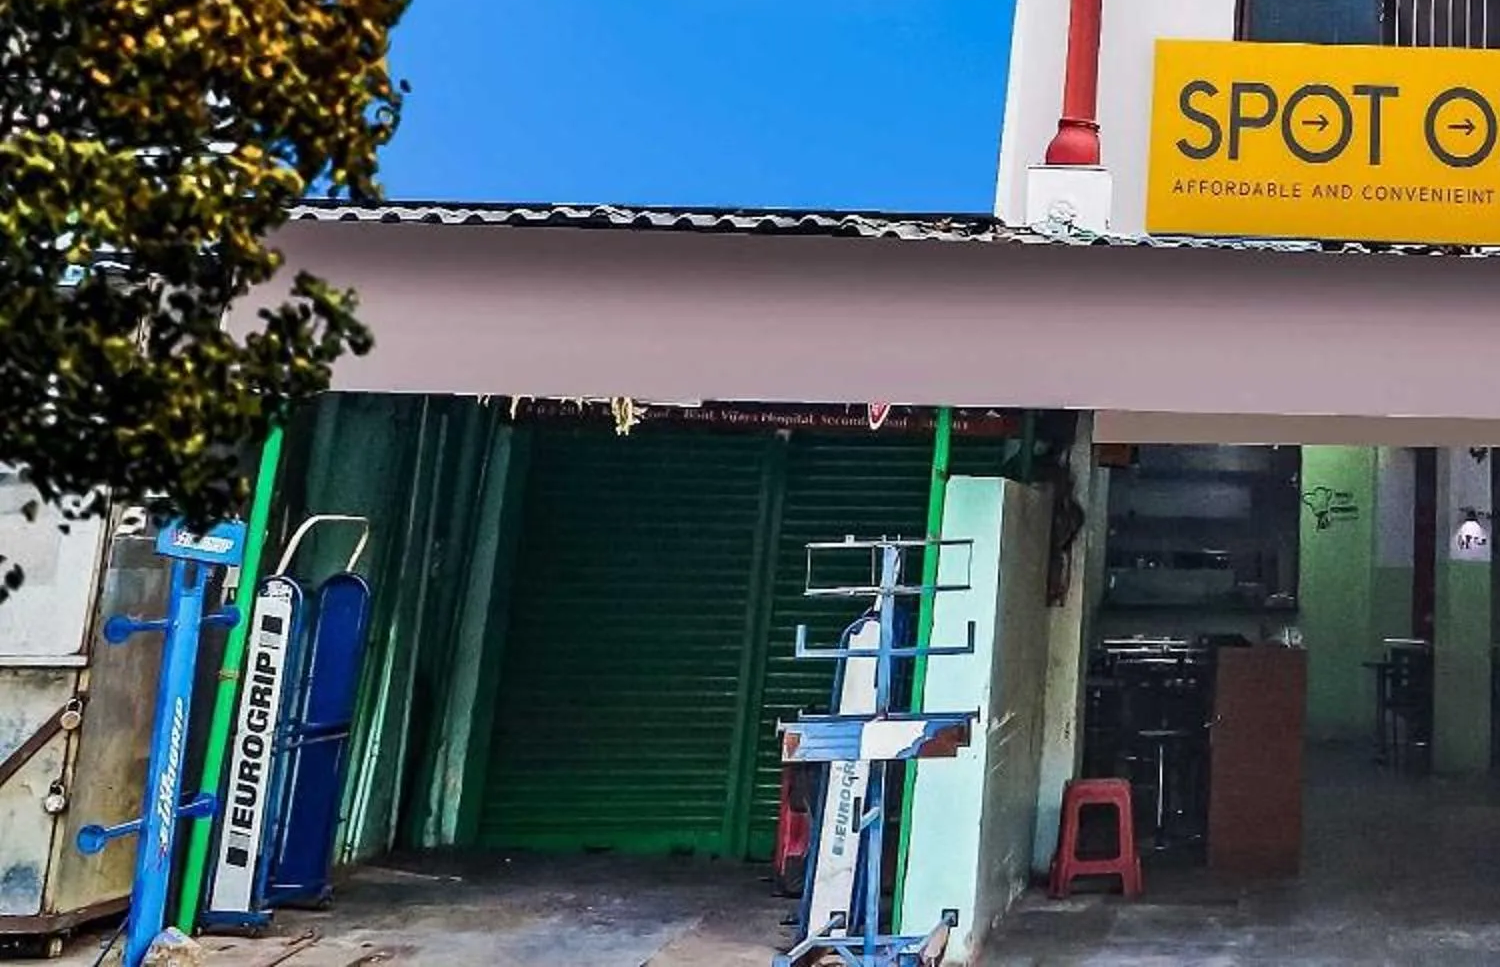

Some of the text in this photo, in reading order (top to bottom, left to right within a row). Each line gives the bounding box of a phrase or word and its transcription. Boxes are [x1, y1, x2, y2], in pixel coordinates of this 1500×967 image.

[1176, 80, 1399, 166] SPOT
[1172, 178, 1302, 198] AFFORDABLE
[1312, 183, 1352, 200] AND
[231, 651, 277, 830] EUROGRIP
